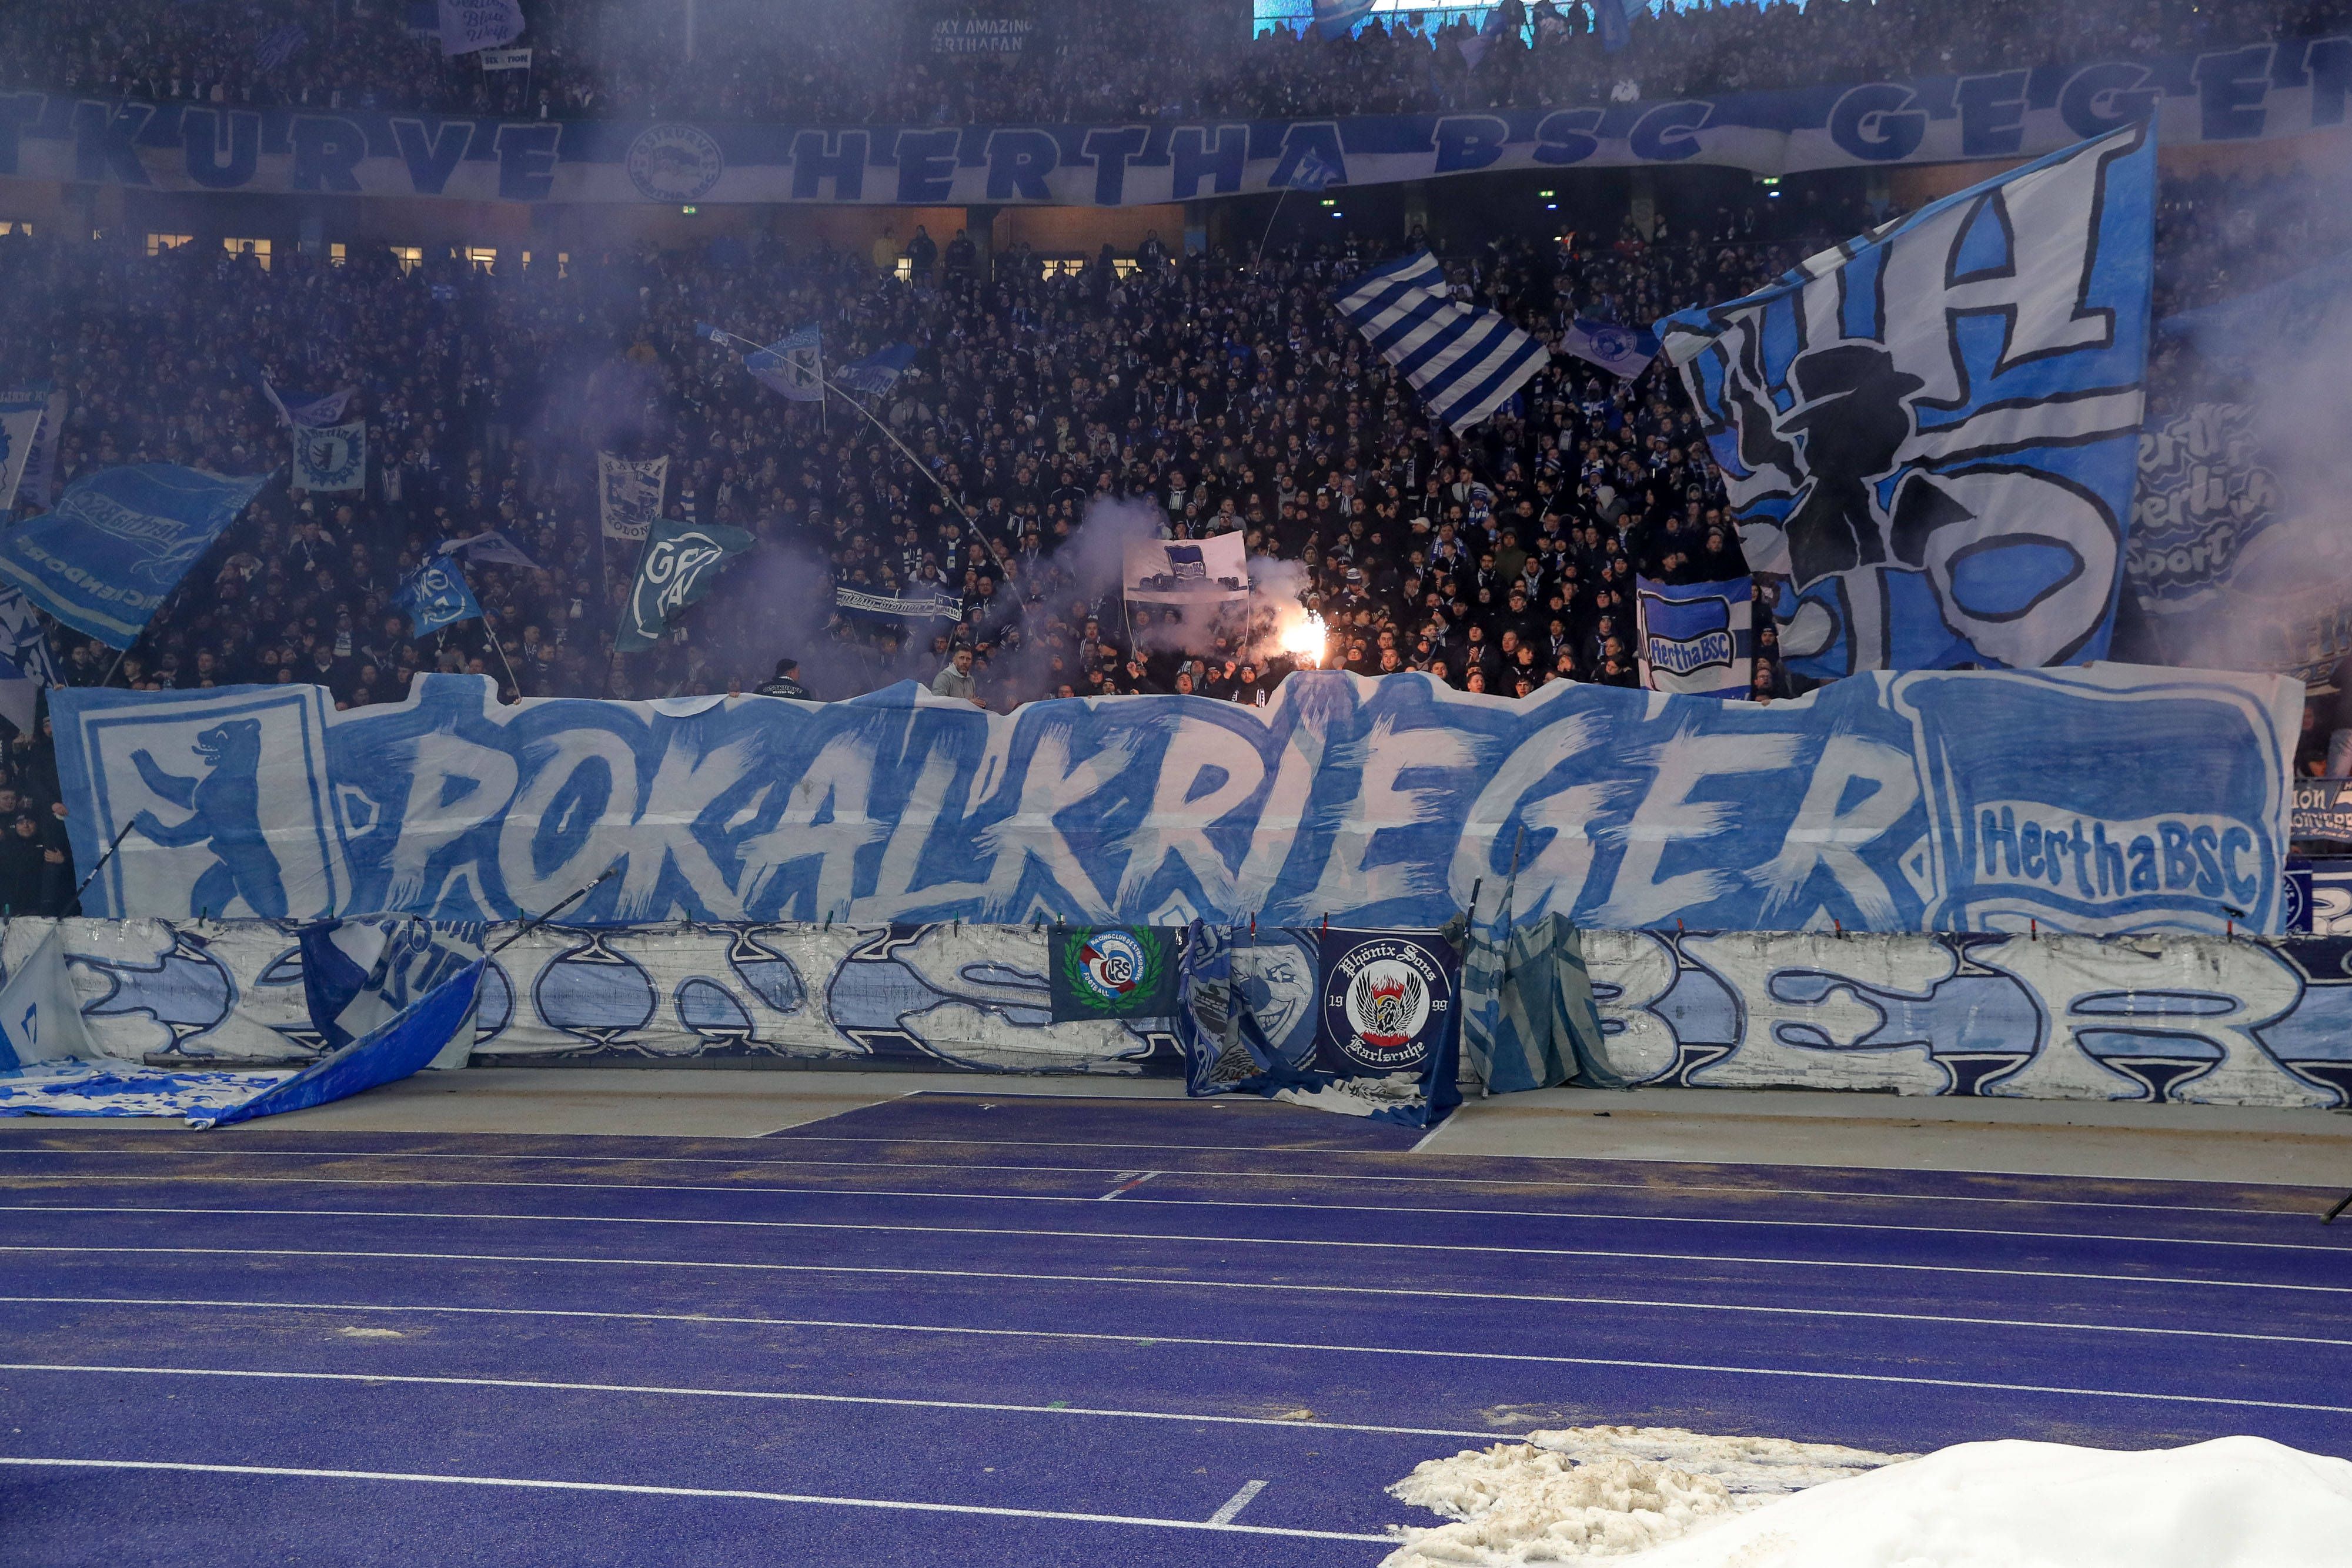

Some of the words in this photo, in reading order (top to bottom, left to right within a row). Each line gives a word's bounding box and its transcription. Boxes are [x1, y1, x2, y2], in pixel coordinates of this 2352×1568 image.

[789, 122, 1347, 205] HERTHA
[1432, 100, 1715, 175] BSC
[379, 706, 1922, 928] POKALKRIEGER
[1979, 805, 2260, 905] HerthaBSC
[1338, 943, 1396, 978] Phönix
[1396, 944, 1437, 982] Sons
[1083, 971, 1110, 997] FOOTBALL
[1328, 995, 1344, 1007] 19
[1431, 999, 1448, 1012] 99
[1345, 1034, 1425, 1062] Karlsruhe
